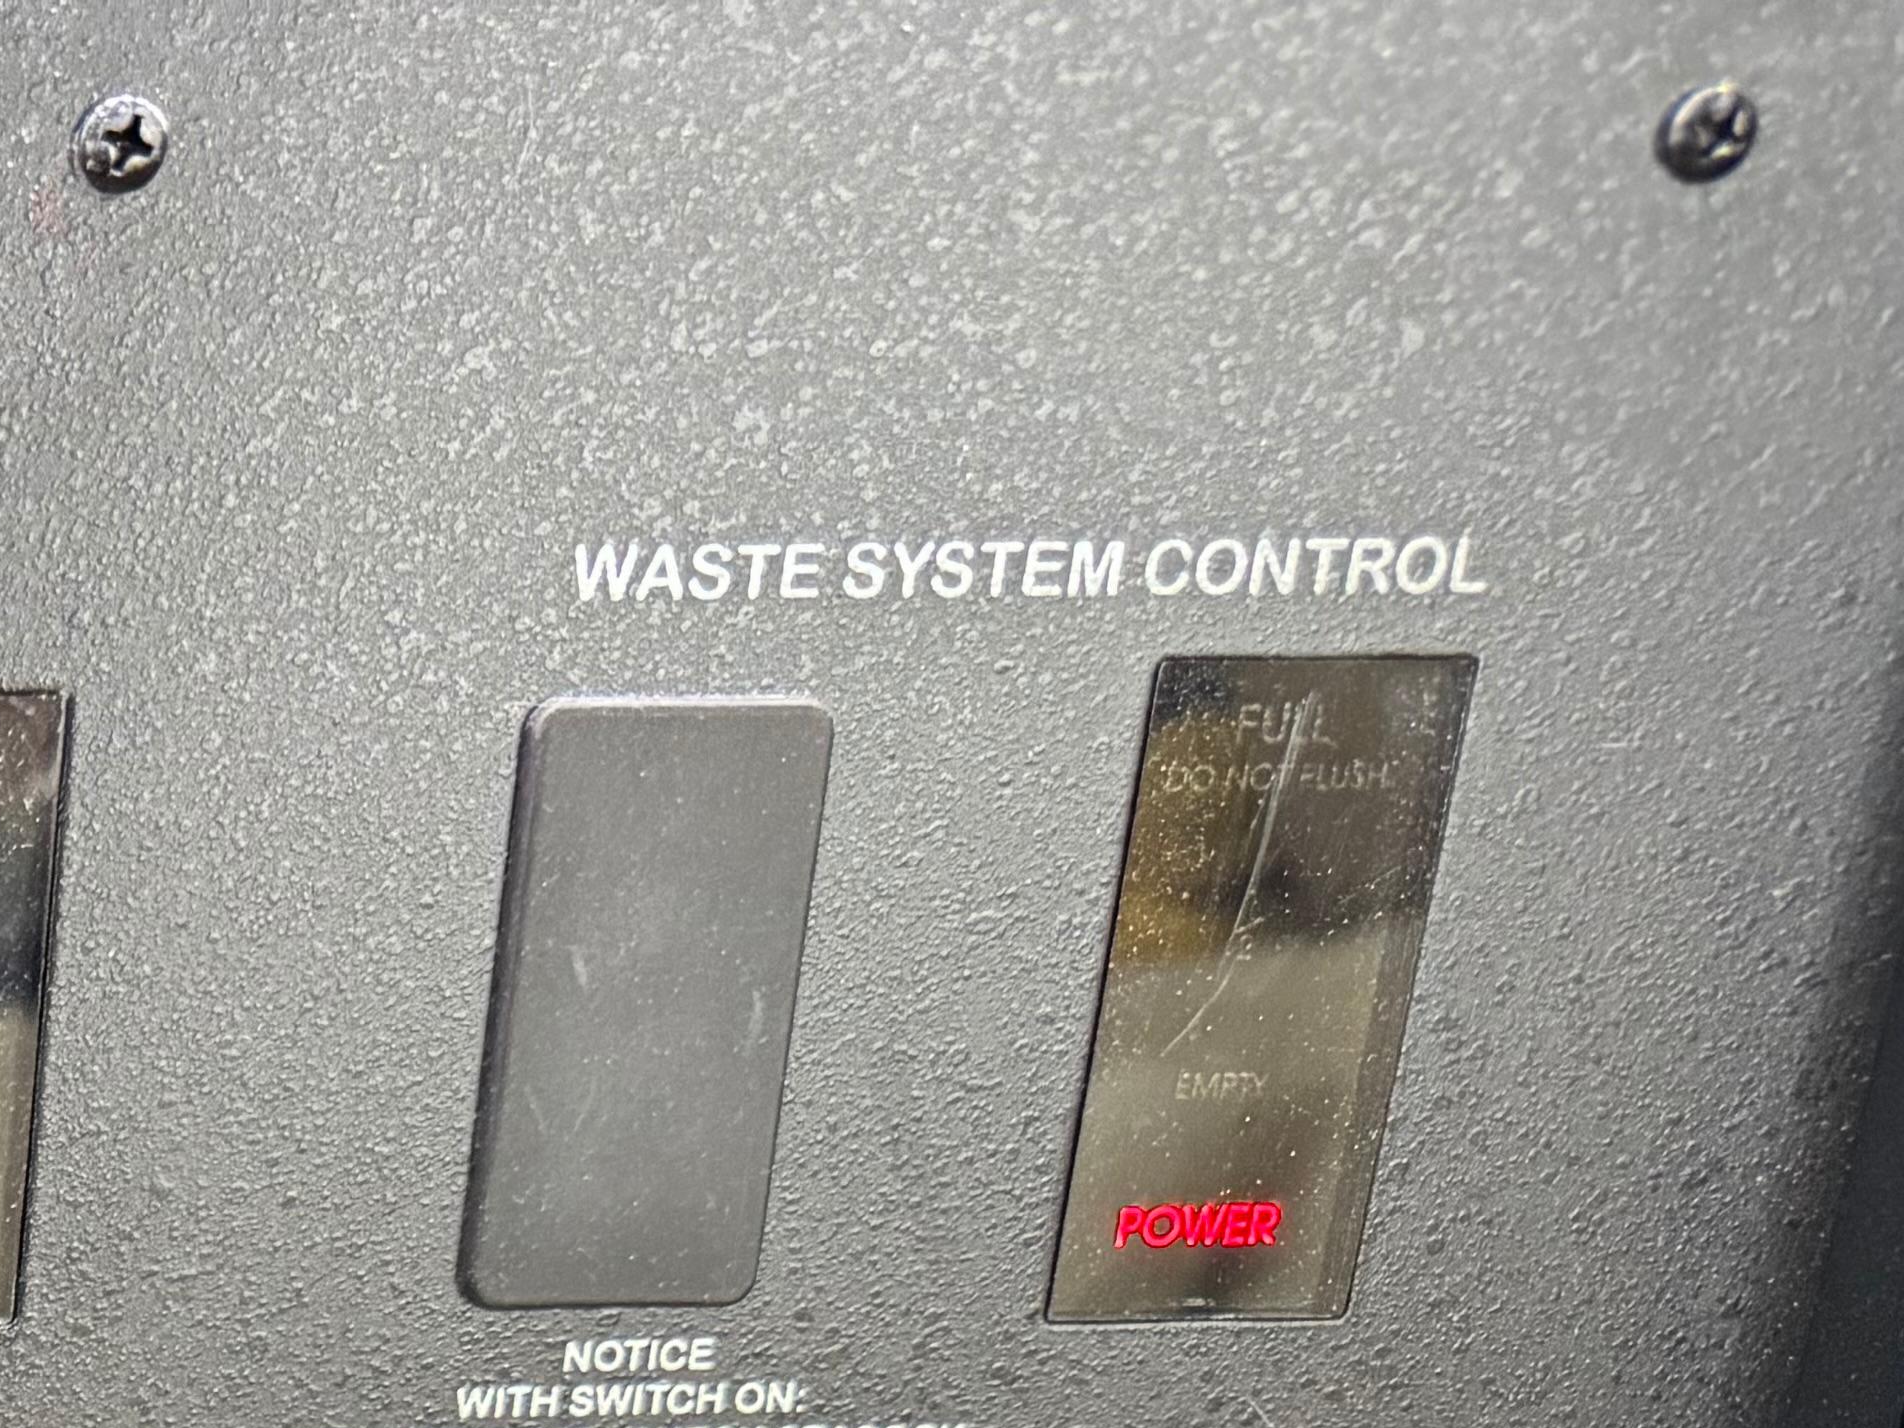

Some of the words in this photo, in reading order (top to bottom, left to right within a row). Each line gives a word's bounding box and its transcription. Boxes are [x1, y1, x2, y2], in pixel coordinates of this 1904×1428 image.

[574, 537, 828, 602] WASTE
[842, 535, 1126, 599] SYSTEM
[1144, 528, 1487, 597] CONTROL
[1175, 1070, 1268, 1100] EMPTY
[1113, 1202, 1282, 1249] POWER
[562, 1336, 716, 1372] NOTICE
[456, 1384, 565, 1420] WITH
[568, 1379, 729, 1417] SWITCH
[734, 1379, 809, 1414] ON:
